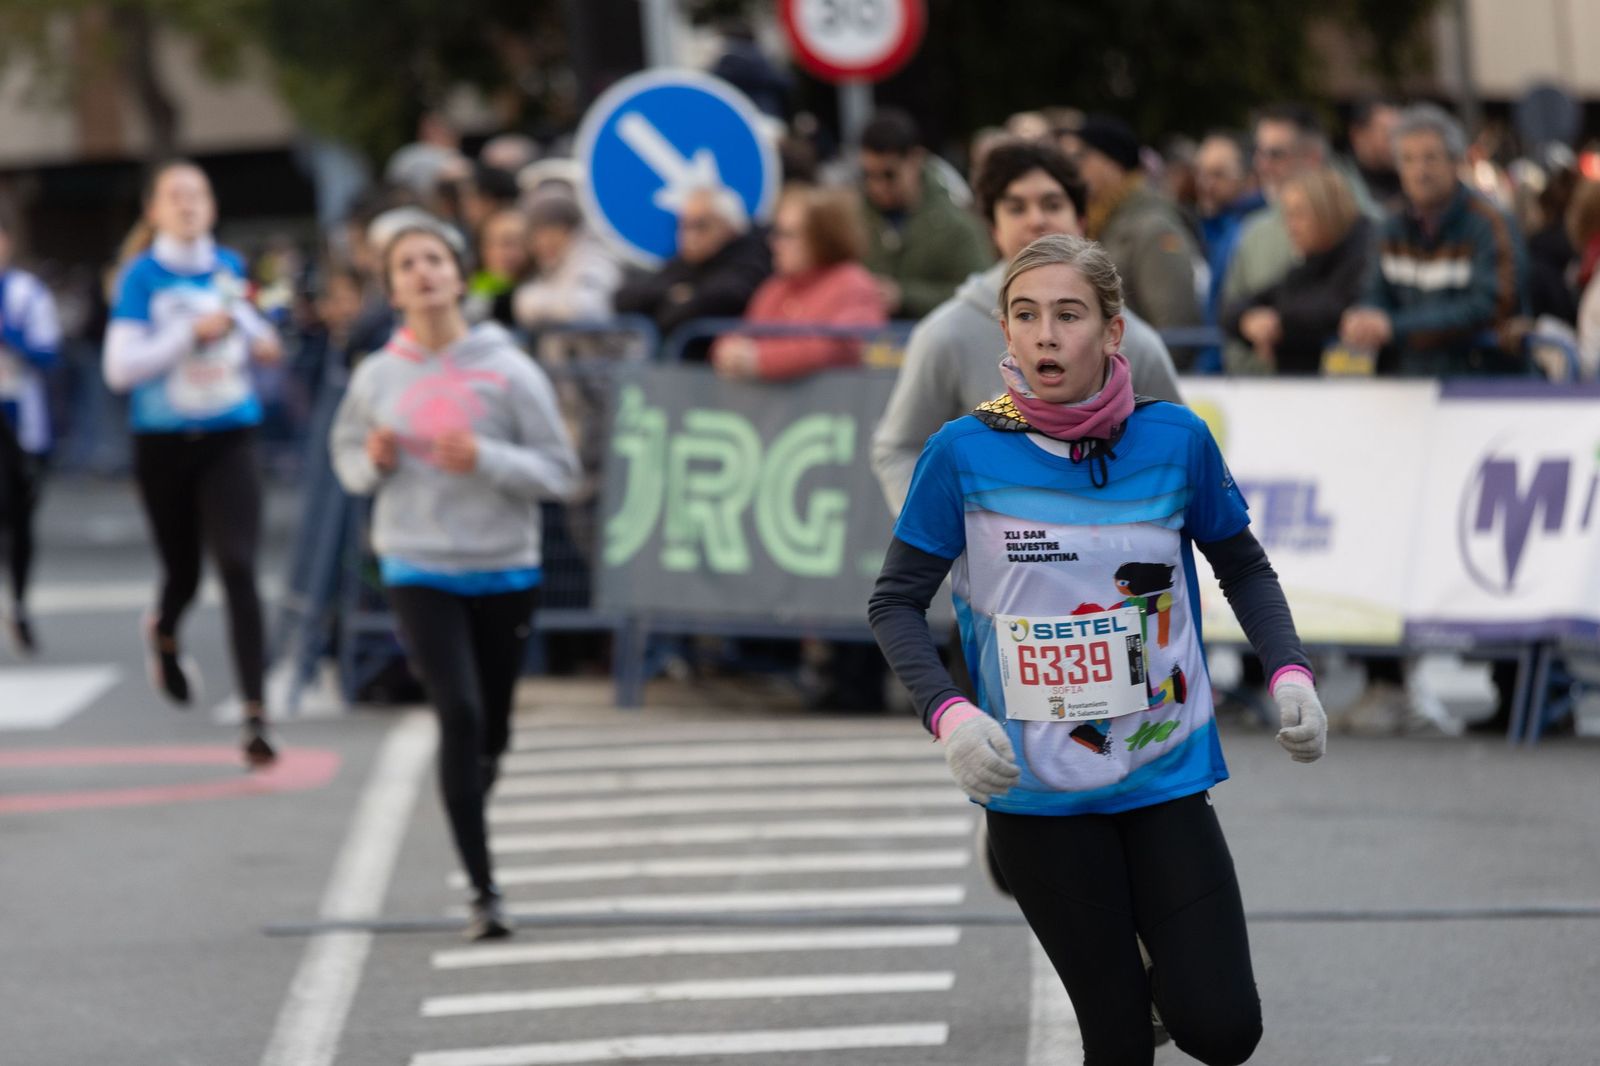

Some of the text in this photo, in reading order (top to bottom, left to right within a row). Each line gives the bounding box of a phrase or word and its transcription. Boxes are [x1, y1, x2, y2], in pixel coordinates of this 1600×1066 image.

[603, 386, 856, 576] JRG
[1004, 529, 1046, 540] XLI SAN
[1006, 541, 1060, 552] SILVESTRE
[1008, 552, 1079, 563] SALMANTINA
[1033, 616, 1128, 640] SETEL
[1018, 641, 1113, 686] 6339
[1052, 685, 1084, 695] SOFIA
[1067, 700, 1108, 710] Ayuntamiento
[1068, 708, 1109, 718] de Salamanca
